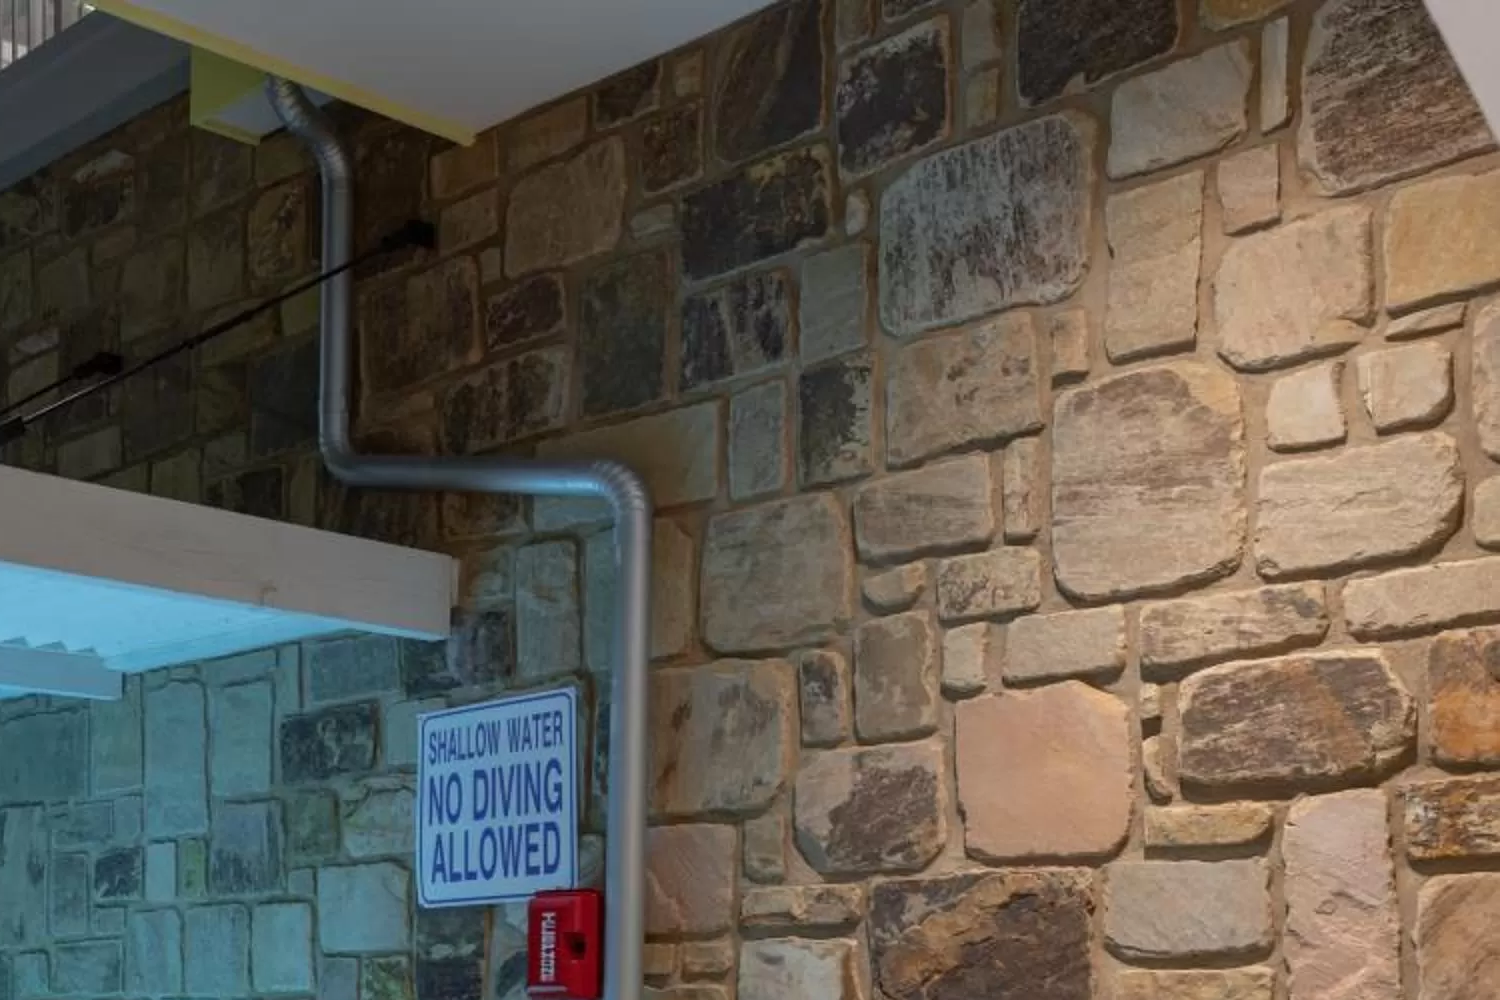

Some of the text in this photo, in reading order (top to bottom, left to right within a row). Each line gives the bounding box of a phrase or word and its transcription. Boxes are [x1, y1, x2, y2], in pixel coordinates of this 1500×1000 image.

[429, 711, 563, 765] SHALLOW WATER
[429, 757, 562, 826] NO DIVING
[432, 821, 561, 883] ALLOWED
